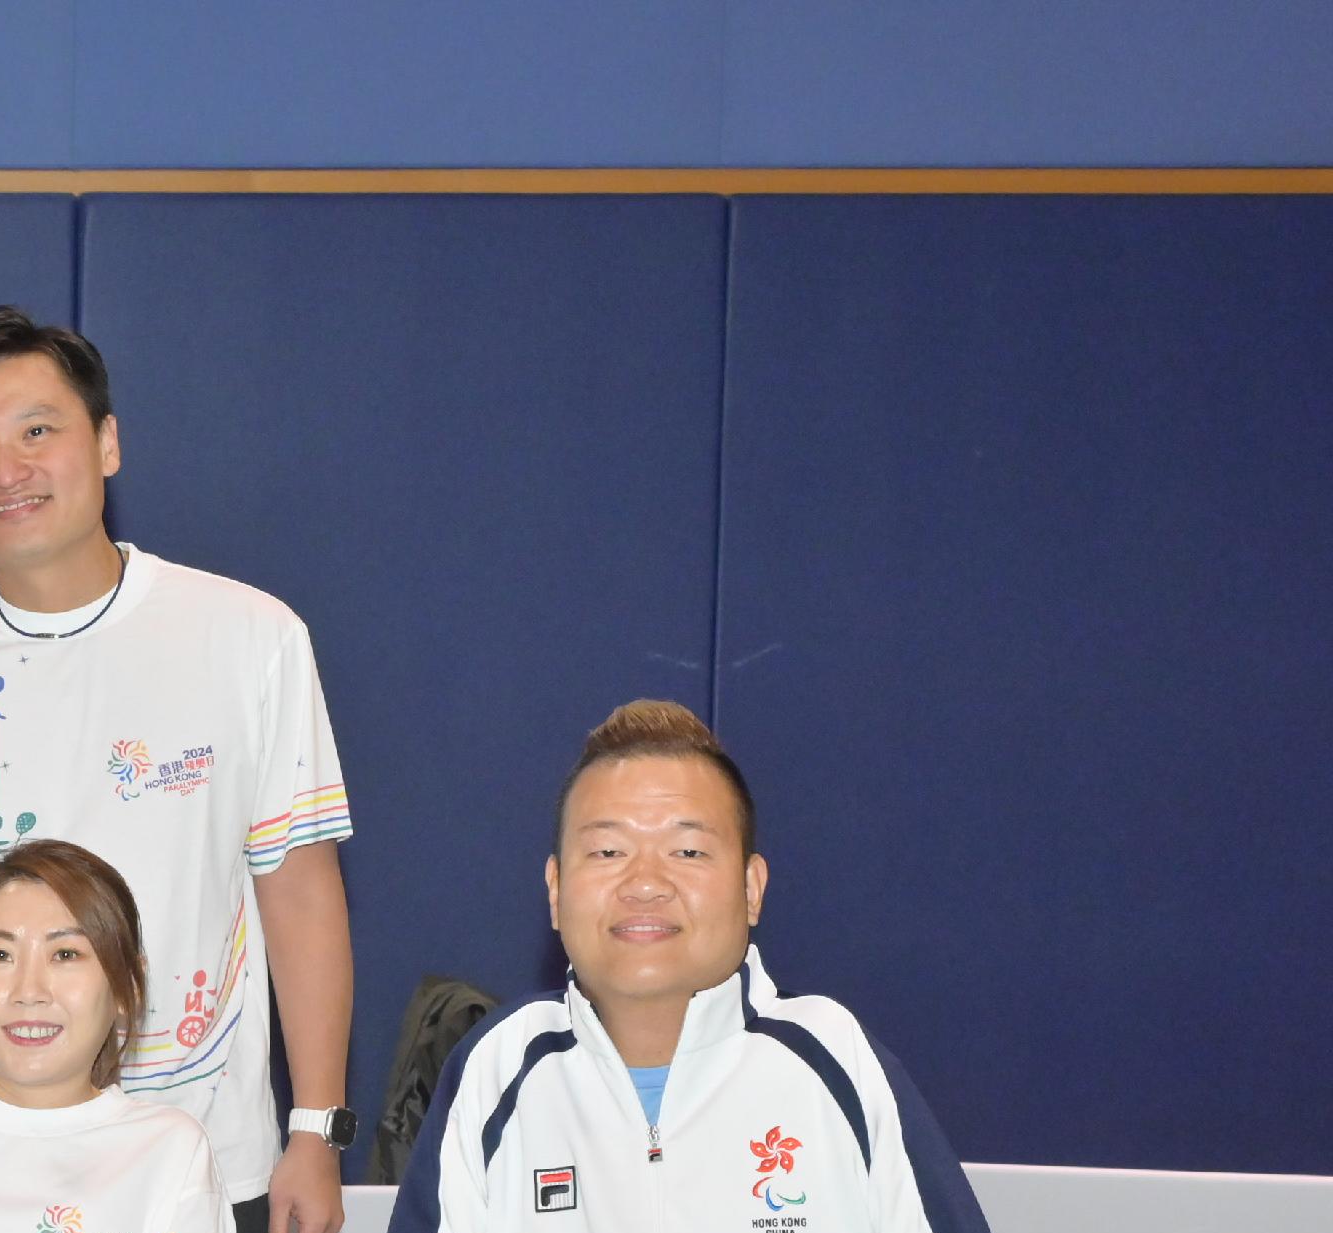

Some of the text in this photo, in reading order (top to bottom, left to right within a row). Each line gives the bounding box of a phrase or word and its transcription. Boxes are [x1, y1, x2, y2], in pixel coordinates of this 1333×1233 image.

[182, 745, 213, 760] 2024
[145, 770, 202, 790] HONG KONG
[164, 777, 210, 792] PARALYMPIC
[752, 1217, 807, 1229] HONG KONG
